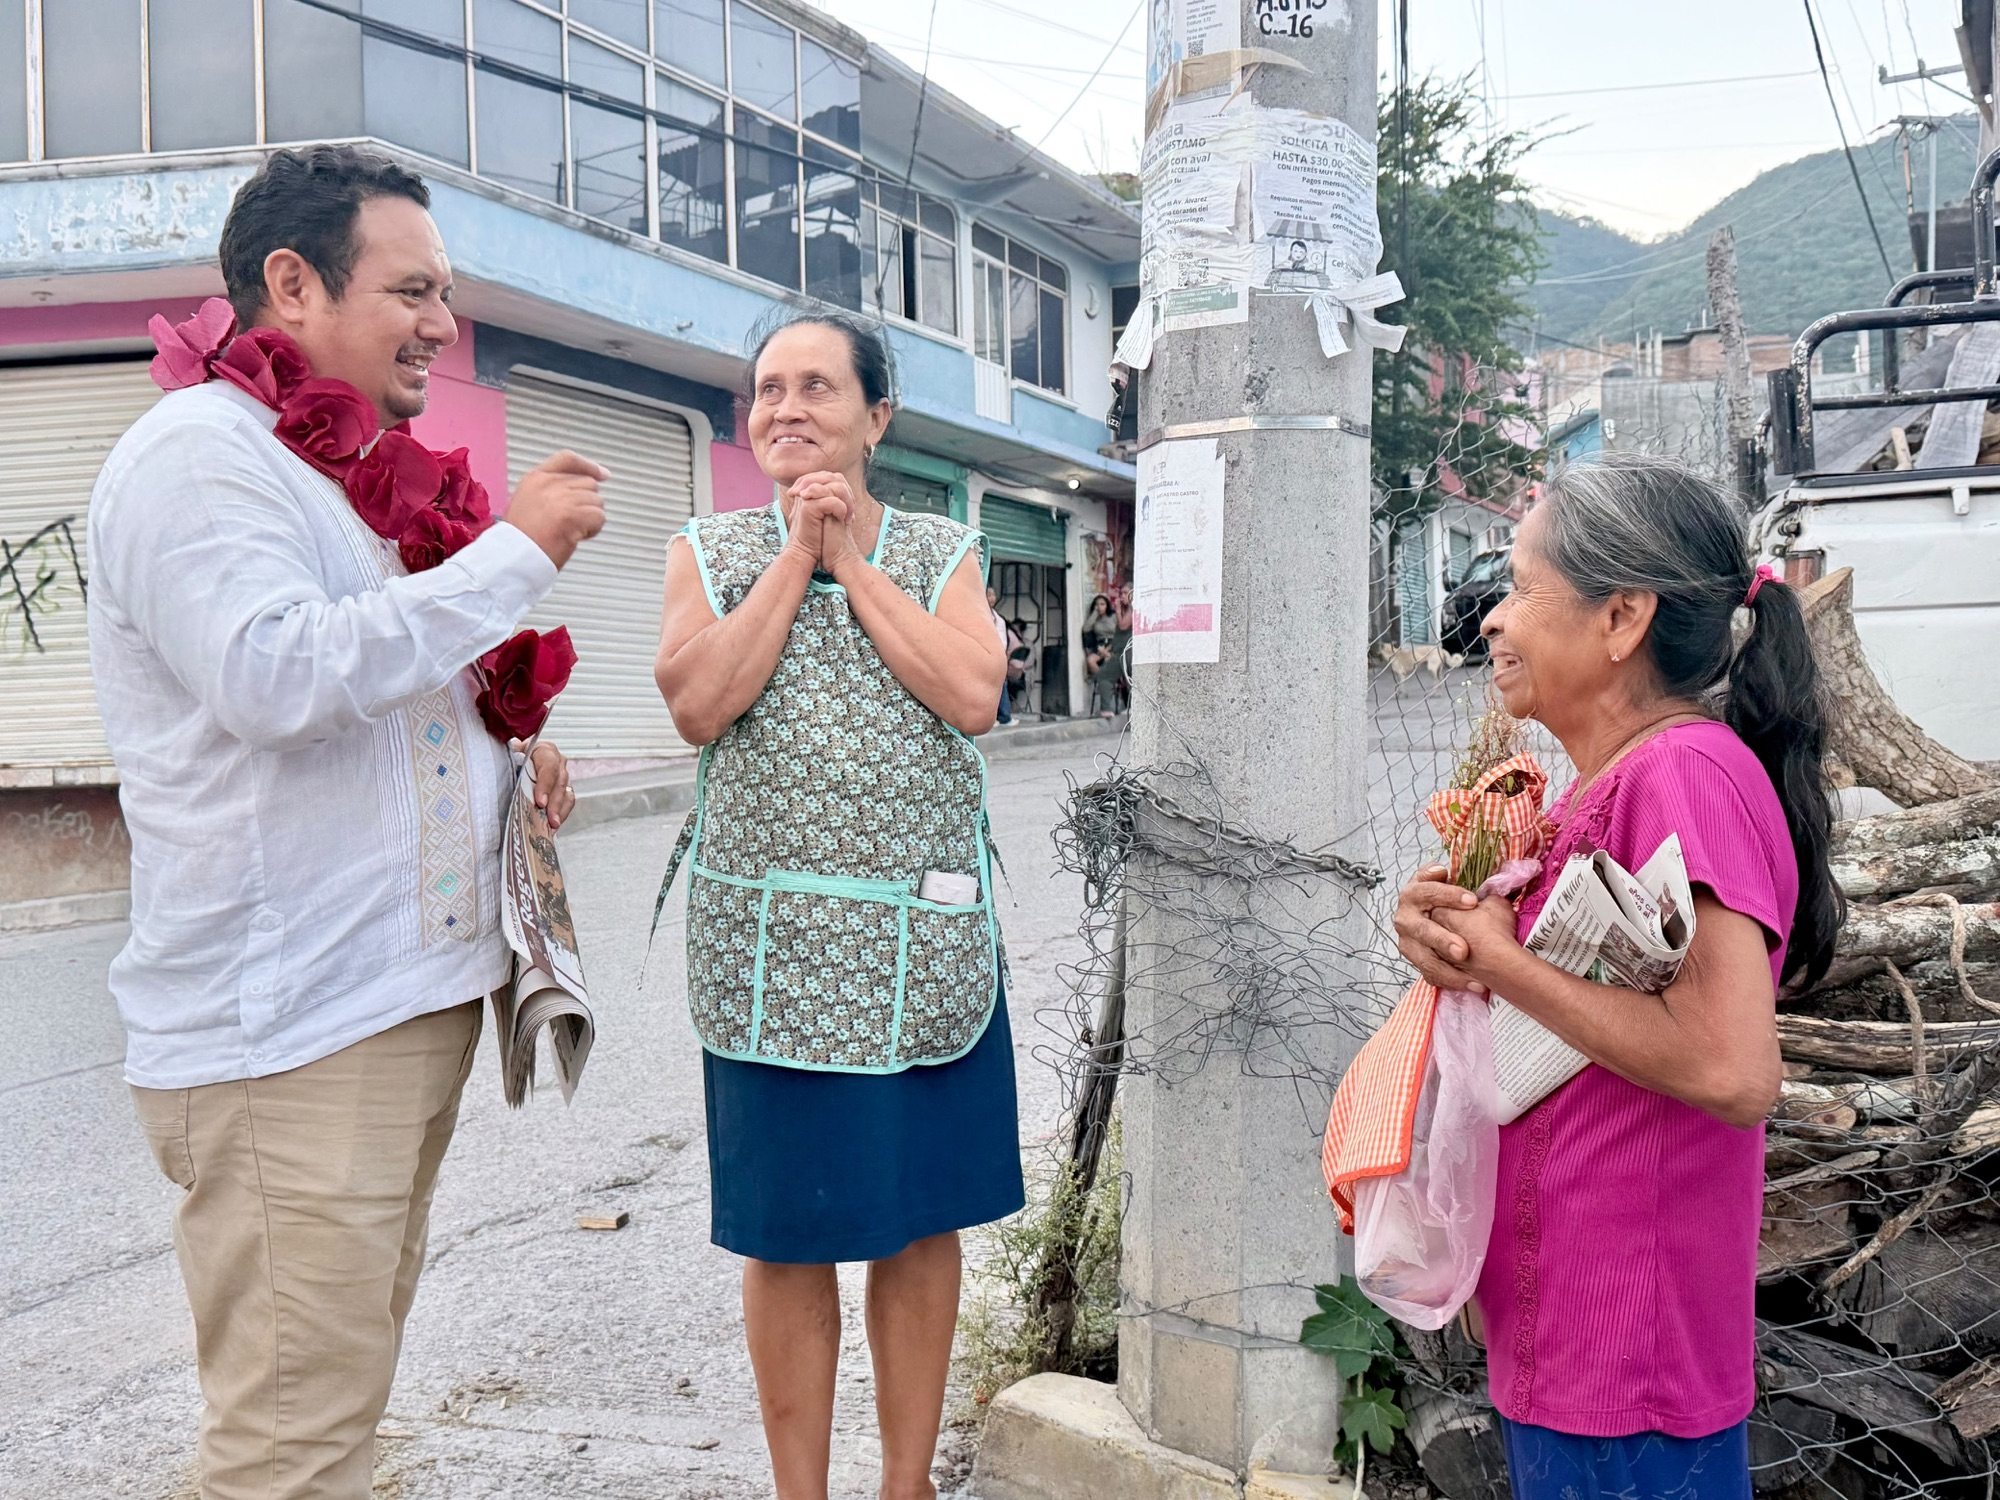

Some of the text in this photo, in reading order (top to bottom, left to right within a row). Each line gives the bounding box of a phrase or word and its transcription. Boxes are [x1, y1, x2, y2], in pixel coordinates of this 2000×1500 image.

[1281, 135, 1328, 151] SOLICITA
[1273, 150, 1307, 165] HASTA
[1292, 165, 1318, 174] INTERÉS
[1319, 168, 1333, 176] MUY
[1302, 176, 1320, 186] Pagos
[1309, 187, 1335, 196] negocio
